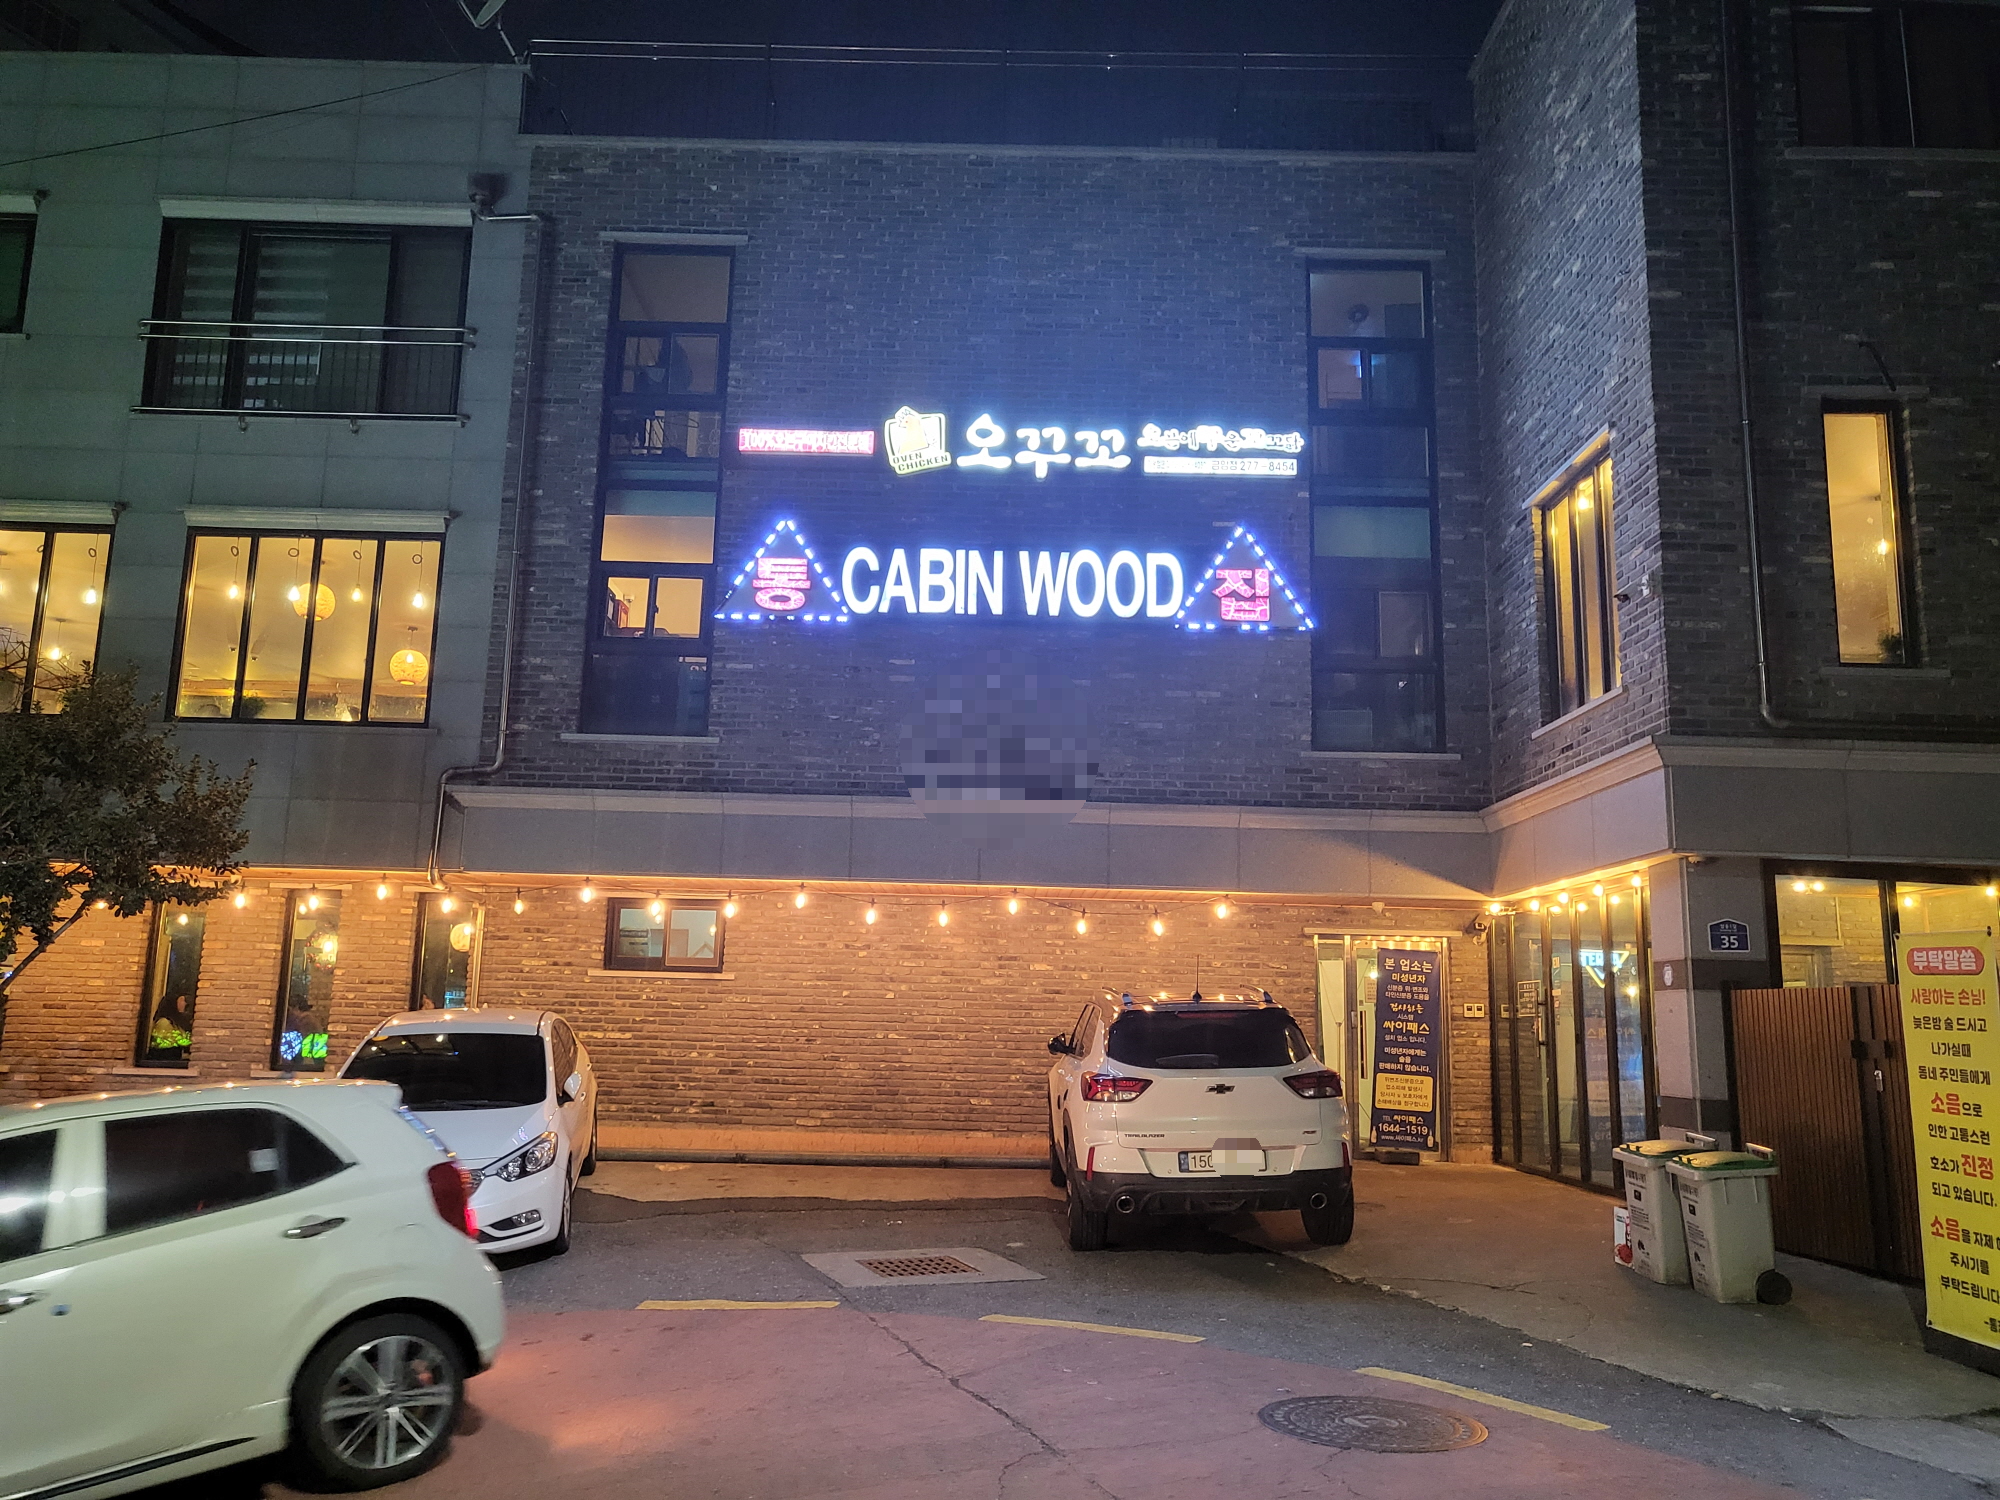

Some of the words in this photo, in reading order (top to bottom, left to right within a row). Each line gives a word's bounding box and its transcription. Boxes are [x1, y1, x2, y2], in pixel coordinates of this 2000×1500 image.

[956, 413, 1131, 479] 오꾸꼬
[892, 452, 923, 464] OVEN
[898, 454, 950, 472] CHICKEN
[1240, 460, 1295, 472] 277-8454
[752, 557, 812, 610] 통
[841, 547, 1003, 616] CABIN
[1018, 549, 1185, 618] WOOD
[1213, 568, 1270, 622] 집
[1720, 936, 1738, 948] 35
[1384, 958, 1395, 970] 본
[1400, 958, 1433, 972] 업소는
[1580, 952, 1622, 968] TERA
[1913, 950, 1976, 970] 부탁말씀
[1392, 973, 1426, 984] 미성년자
[1911, 988, 1955, 1005] 사랑하는
[1958, 989, 1986, 1005] 손님!
[1390, 1003, 1424, 1014] 검사하는
[1383, 1021, 1430, 1034] 싸이패스
[1913, 1016, 1942, 1030] 늦은밤
[1944, 1016, 1954, 1031] 술
[1956, 1017, 1987, 1032] 드시고
[1384, 1047, 1426, 1056] 미성년자에게는
[1931, 1042, 1971, 1057] 나가실때
[1379, 1063, 1403, 1071] 판매하지
[1405, 1064, 1431, 1073] 않습니다.
[1918, 1066, 1937, 1080] 동네
[1939, 1067, 1991, 1085] 주민들에게
[1931, 1092, 1983, 1117] 소음으로
[1393, 1115, 1424, 1124] 싸이패스
[1378, 1123, 1428, 1135] 1644-1519
[1928, 1123, 1947, 1139] 인한
[1950, 1127, 1990, 1145] 고통스런
[1930, 1156, 1959, 1174] 호소가
[1961, 1153, 1994, 1180] 진정
[1932, 1182, 1950, 1198] 되고
[1953, 1186, 1997, 1207] 있습니다.
[1930, 1215, 1971, 1244] 소음을
[1974, 1232, 1994, 1250] 자제
[1950, 1252, 1990, 1275] 주시기를
